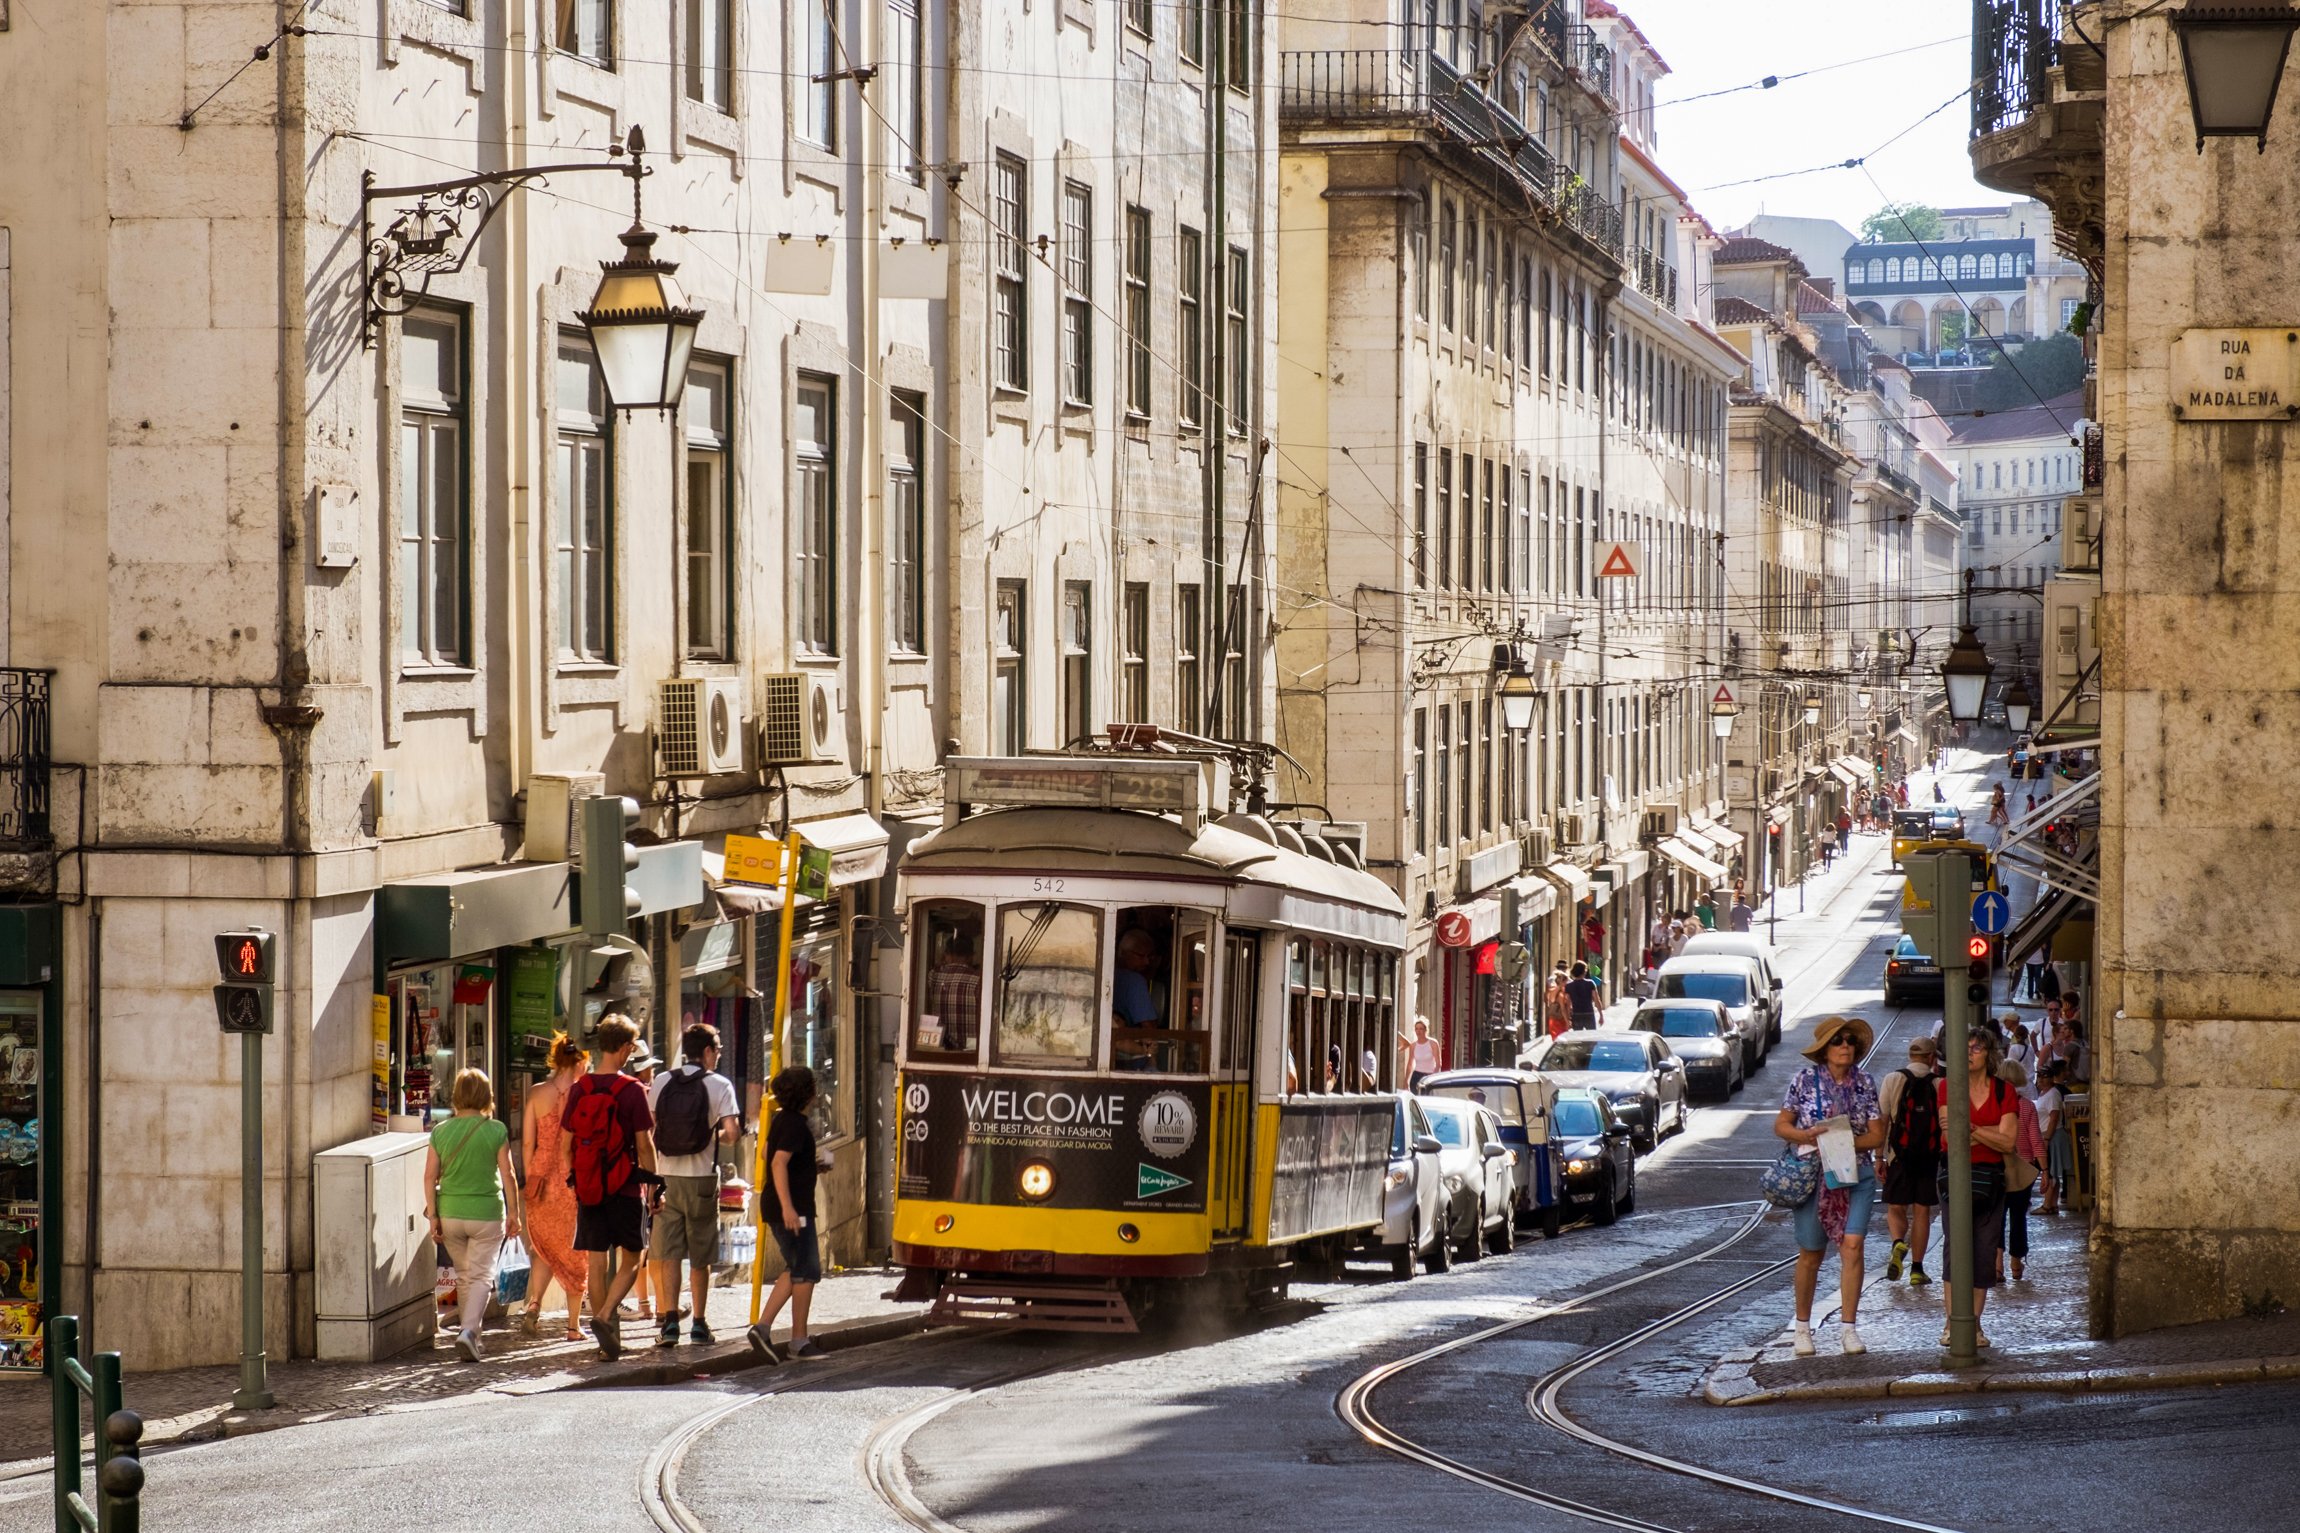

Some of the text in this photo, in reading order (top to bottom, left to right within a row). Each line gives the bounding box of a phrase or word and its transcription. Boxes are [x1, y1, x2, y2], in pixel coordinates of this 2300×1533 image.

[2221, 340, 2250, 354] RUA
[2224, 366, 2245, 380] DA
[2189, 391, 2280, 406] MADALENA
[1127, 776, 1169, 802] 28
[1033, 877, 1065, 893] 542
[961, 1088, 1124, 1125] WELCOME
[968, 1121, 1112, 1138] TO THE BEST PLACE IN FASHION
[1154, 1125, 1184, 1135] REWARD
[967, 1136, 1112, 1150] BEM-VINDO AO MELHOR LUGAR DA MODA
